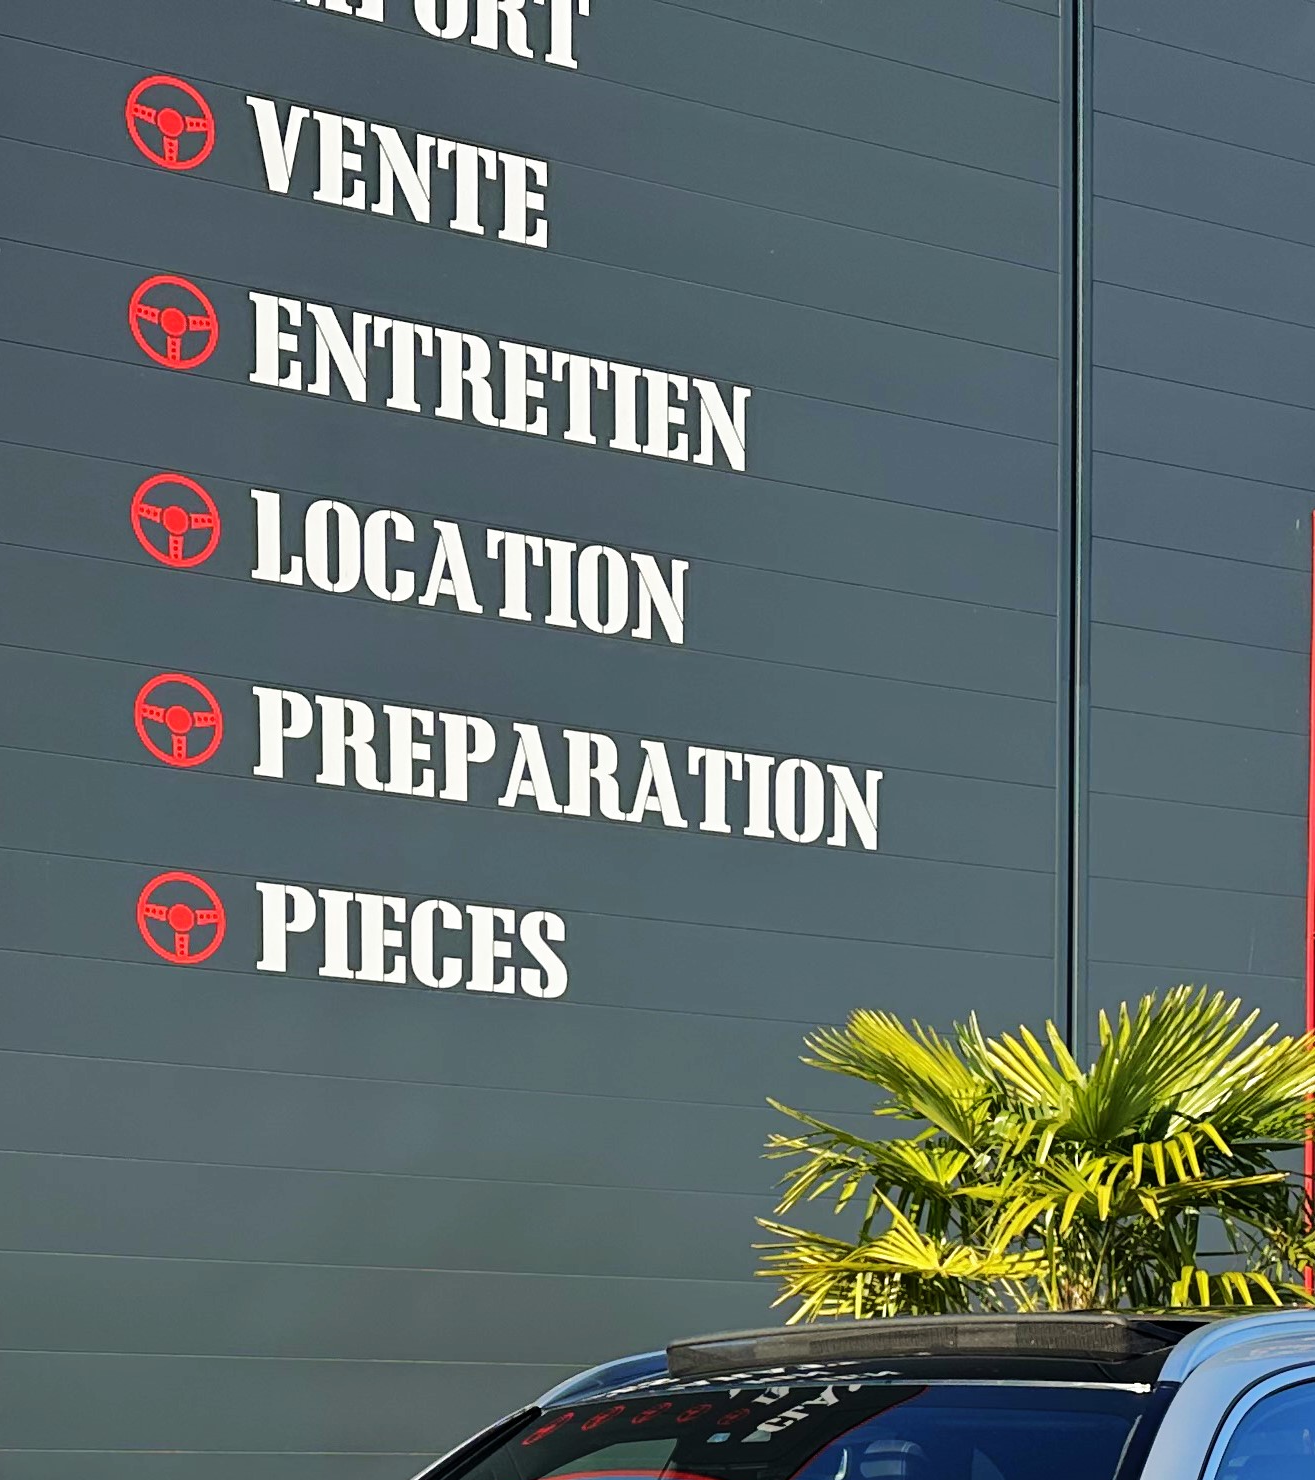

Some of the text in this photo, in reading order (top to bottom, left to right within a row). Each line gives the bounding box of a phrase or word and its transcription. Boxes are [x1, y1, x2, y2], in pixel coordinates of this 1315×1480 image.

[246, 95, 548, 248] VENTE
[248, 291, 751, 471] ENTRETIEN
[250, 488, 689, 645] LOCATION
[253, 685, 884, 852] PREPARATION
[256, 881, 570, 999] PIECES
